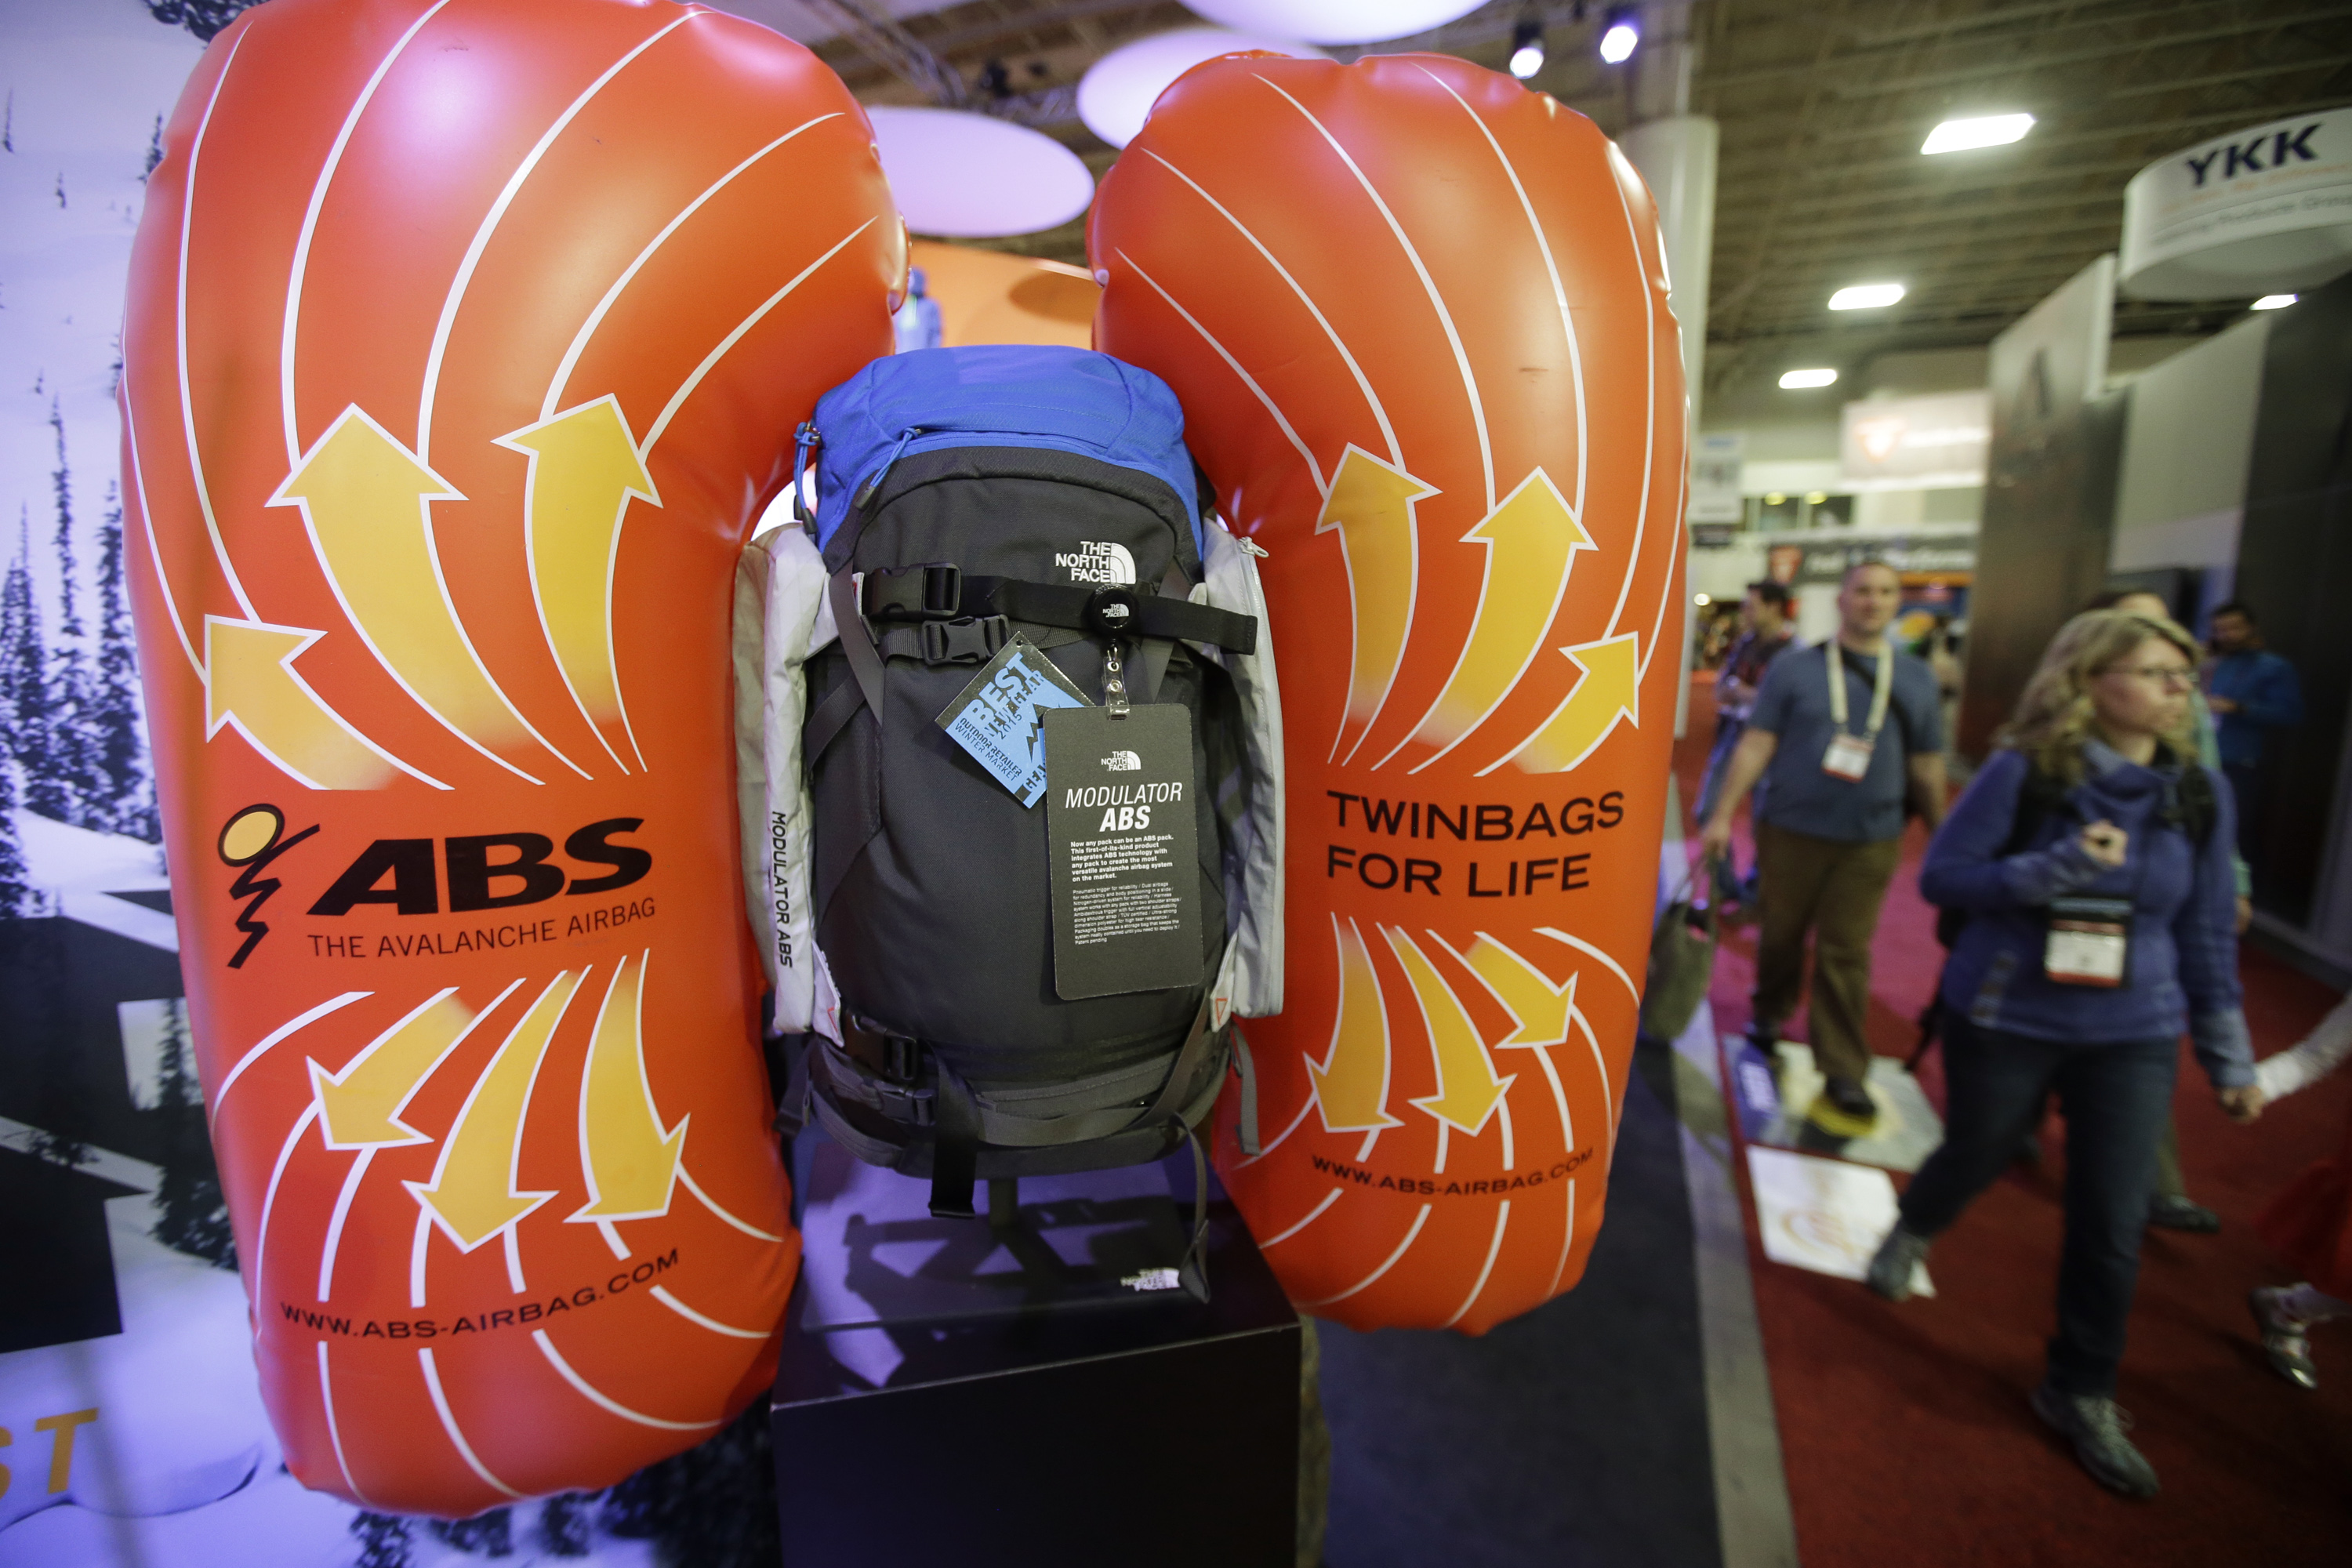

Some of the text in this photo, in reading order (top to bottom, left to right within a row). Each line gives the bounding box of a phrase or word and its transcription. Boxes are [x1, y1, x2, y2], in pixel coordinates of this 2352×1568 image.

[2187, 122, 2321, 186] YKK
[1055, 553, 1109, 569] NORTH
[1080, 541, 1112, 556] THE
[1071, 568, 1111, 583] FACE
[962, 652, 1036, 728] BEST
[984, 670, 1045, 738] NEW GEAR
[955, 723, 1018, 782] WINTER MARKET
[960, 717, 1023, 776] OUTDOOR RETAILER
[996, 712, 1023, 740] 2015
[1065, 782, 1182, 808] MODULATOR
[1099, 805, 1151, 832] ABS
[1327, 789, 1624, 841] TWINBAGS
[305, 817, 652, 916] ABS
[1071, 853, 1102, 862] integrates
[1086, 844, 1133, 853] first-of-its-kind
[1327, 844, 1592, 898] FOR LIFE
[771, 811, 793, 968] MODULATOR ABS
[307, 897, 655, 958] THE AVALANCHE AIRBAG
[1312, 1147, 1594, 1196] WWW.ABS-AIRBAG.COM
[280, 1247, 679, 1339] WWW.ABS-AIRBAG.COM
